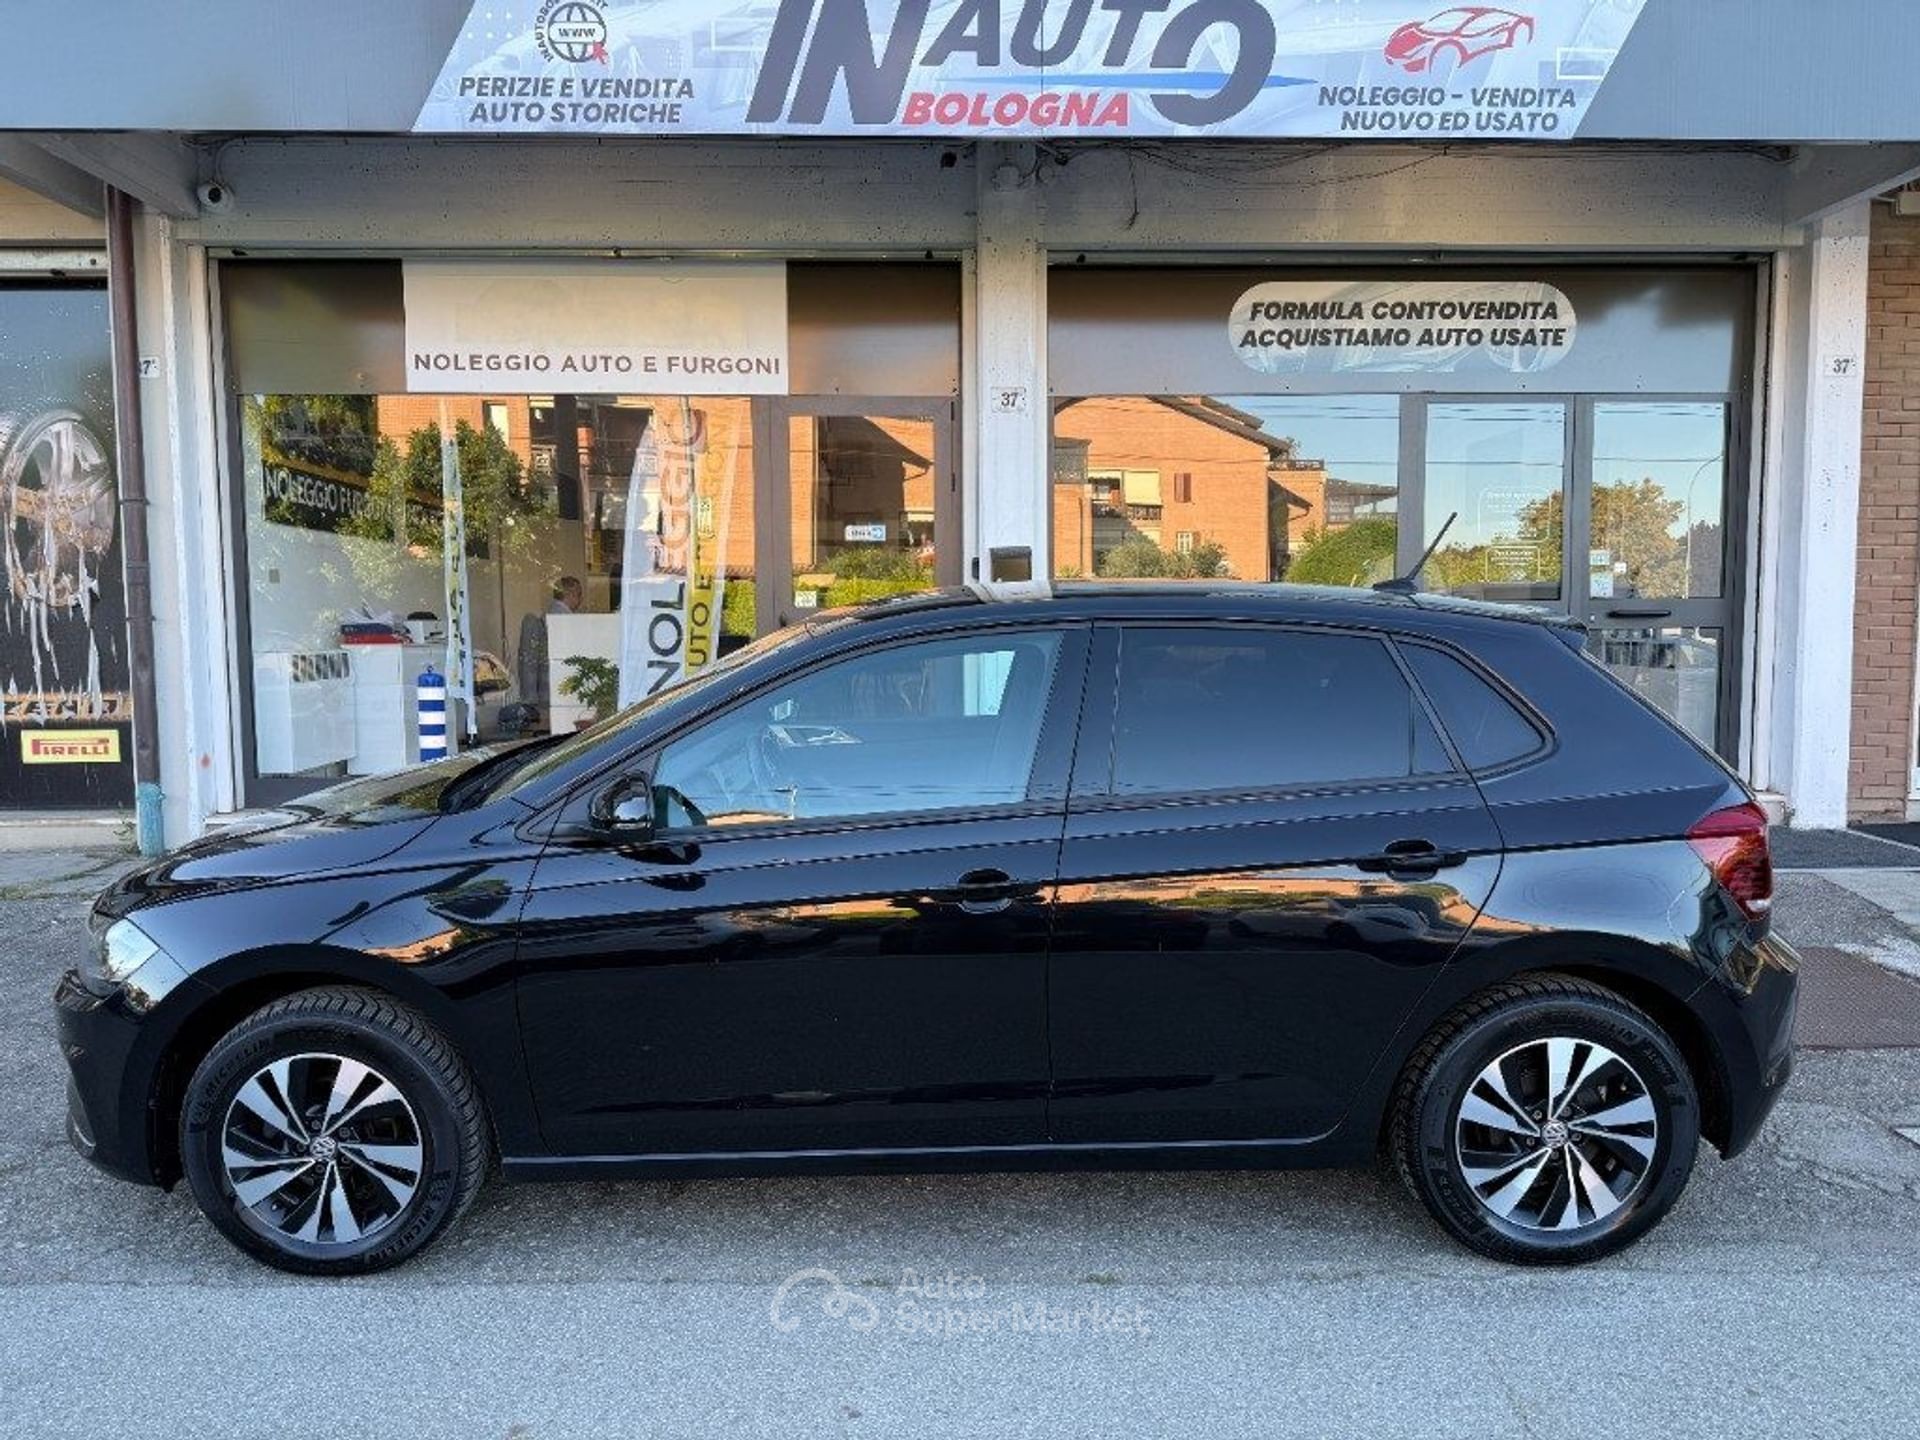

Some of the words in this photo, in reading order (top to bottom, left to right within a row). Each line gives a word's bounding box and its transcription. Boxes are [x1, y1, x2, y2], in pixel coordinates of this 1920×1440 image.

[459, 76, 554, 98] PERIZIE
[560, 77, 574, 98] E
[582, 77, 695, 99] VENDITA
[1317, 86, 1445, 107] NOLEGGIO
[1470, 87, 1577, 108] VENDITA
[469, 103, 546, 123] AUTO
[549, 102, 682, 124] STORICHE
[902, 92, 1130, 127] BOLOGNA
[1340, 111, 1433, 131] NUOVO
[1439, 111, 1470, 131] ED
[1475, 112, 1559, 132] USATO
[1249, 301, 1364, 321] FORMULA
[1371, 301, 1559, 320] CONTOVENDITA
[1239, 328, 1410, 349] ACQUISTIAMO
[1416, 328, 1483, 347] AUTO
[1489, 328, 1567, 347] USATE
[414, 353, 551, 371] NOLEGGIO
[560, 355, 632, 373] AUTO
[643, 355, 658, 373] E
[667, 356, 780, 375] FURGONI
[1001, 391, 1019, 407] 37
[264, 466, 338, 512] NOLEGGIO
[688, 602, 710, 667] UTO
[31, 738, 110, 755] PIRELLI
